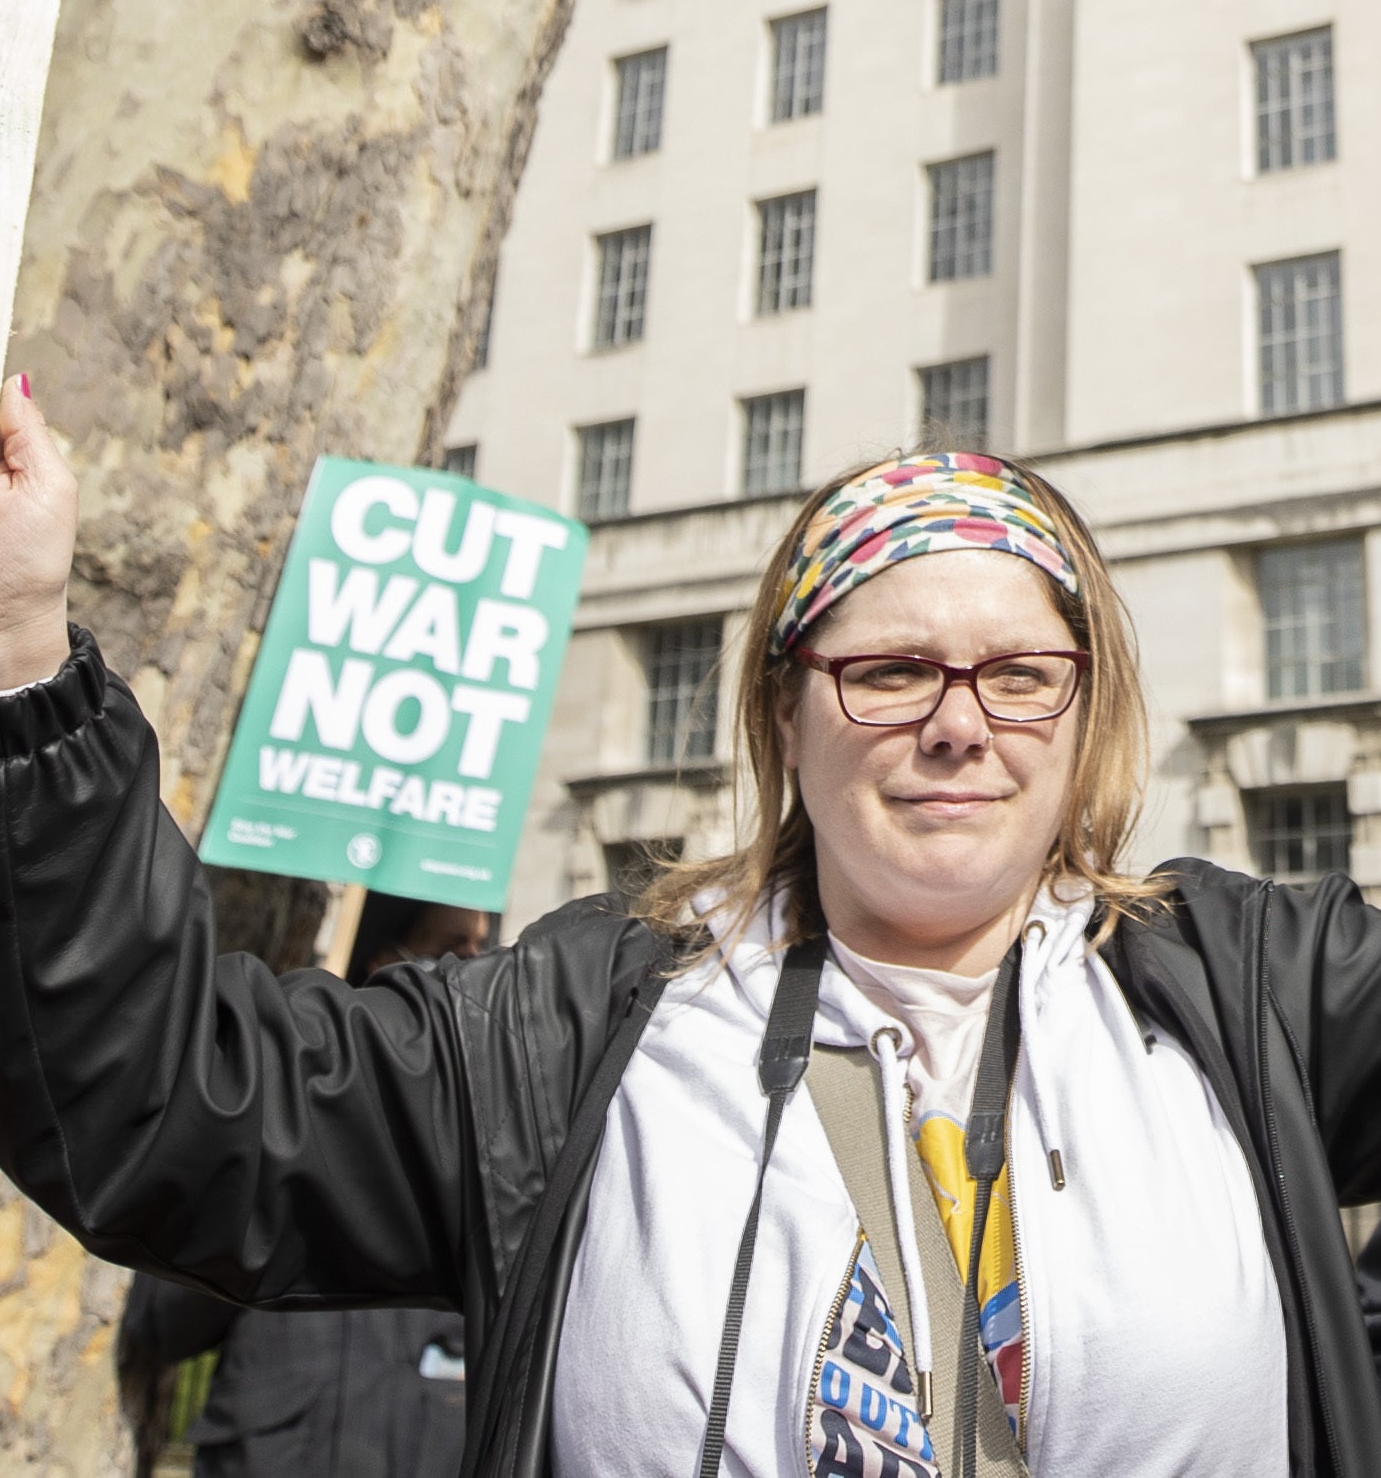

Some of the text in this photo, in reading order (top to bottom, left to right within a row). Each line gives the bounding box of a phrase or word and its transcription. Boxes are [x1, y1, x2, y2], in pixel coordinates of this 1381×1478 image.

[330, 474, 570, 600] CUT
[307, 556, 549, 690] WAR
[269, 646, 532, 780] NOT
[258, 744, 503, 833] WELFARE
